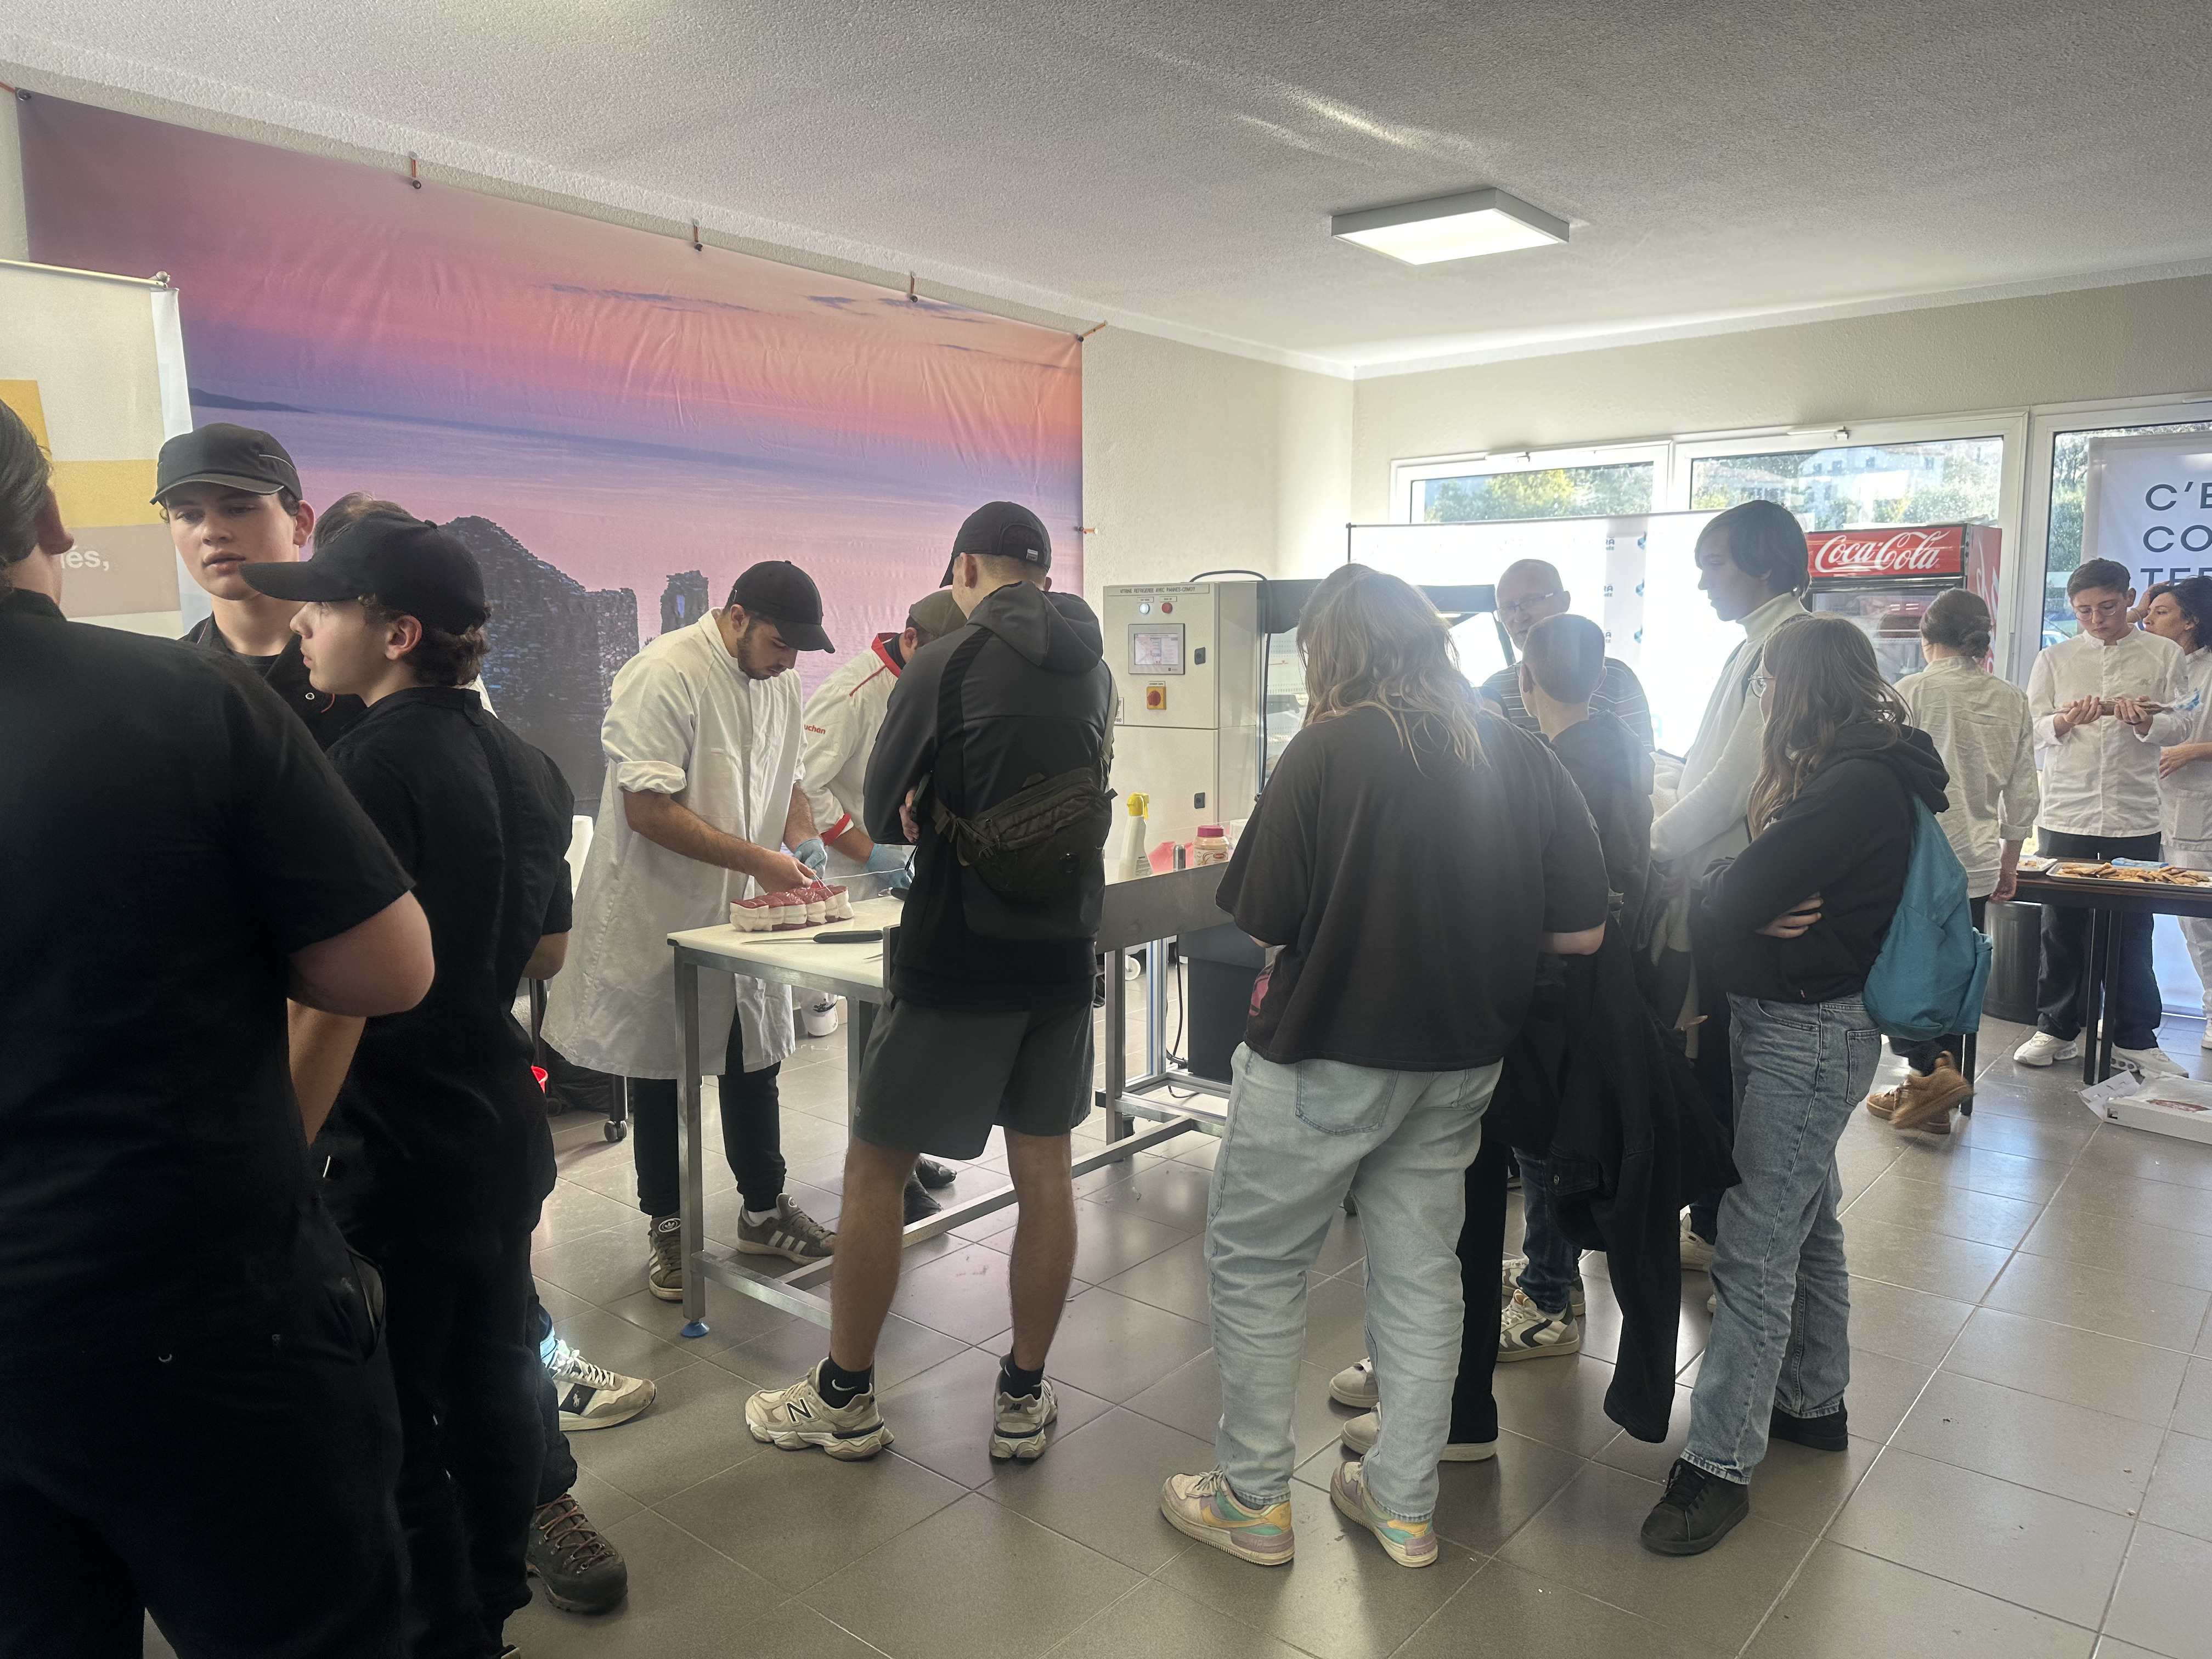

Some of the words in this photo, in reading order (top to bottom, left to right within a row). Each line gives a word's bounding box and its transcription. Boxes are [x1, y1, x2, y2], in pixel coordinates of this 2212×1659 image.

[60, 545, 109, 571] és,
[1815, 531, 1951, 573] Coca-Cola
[804, 724, 826, 735] uchan
